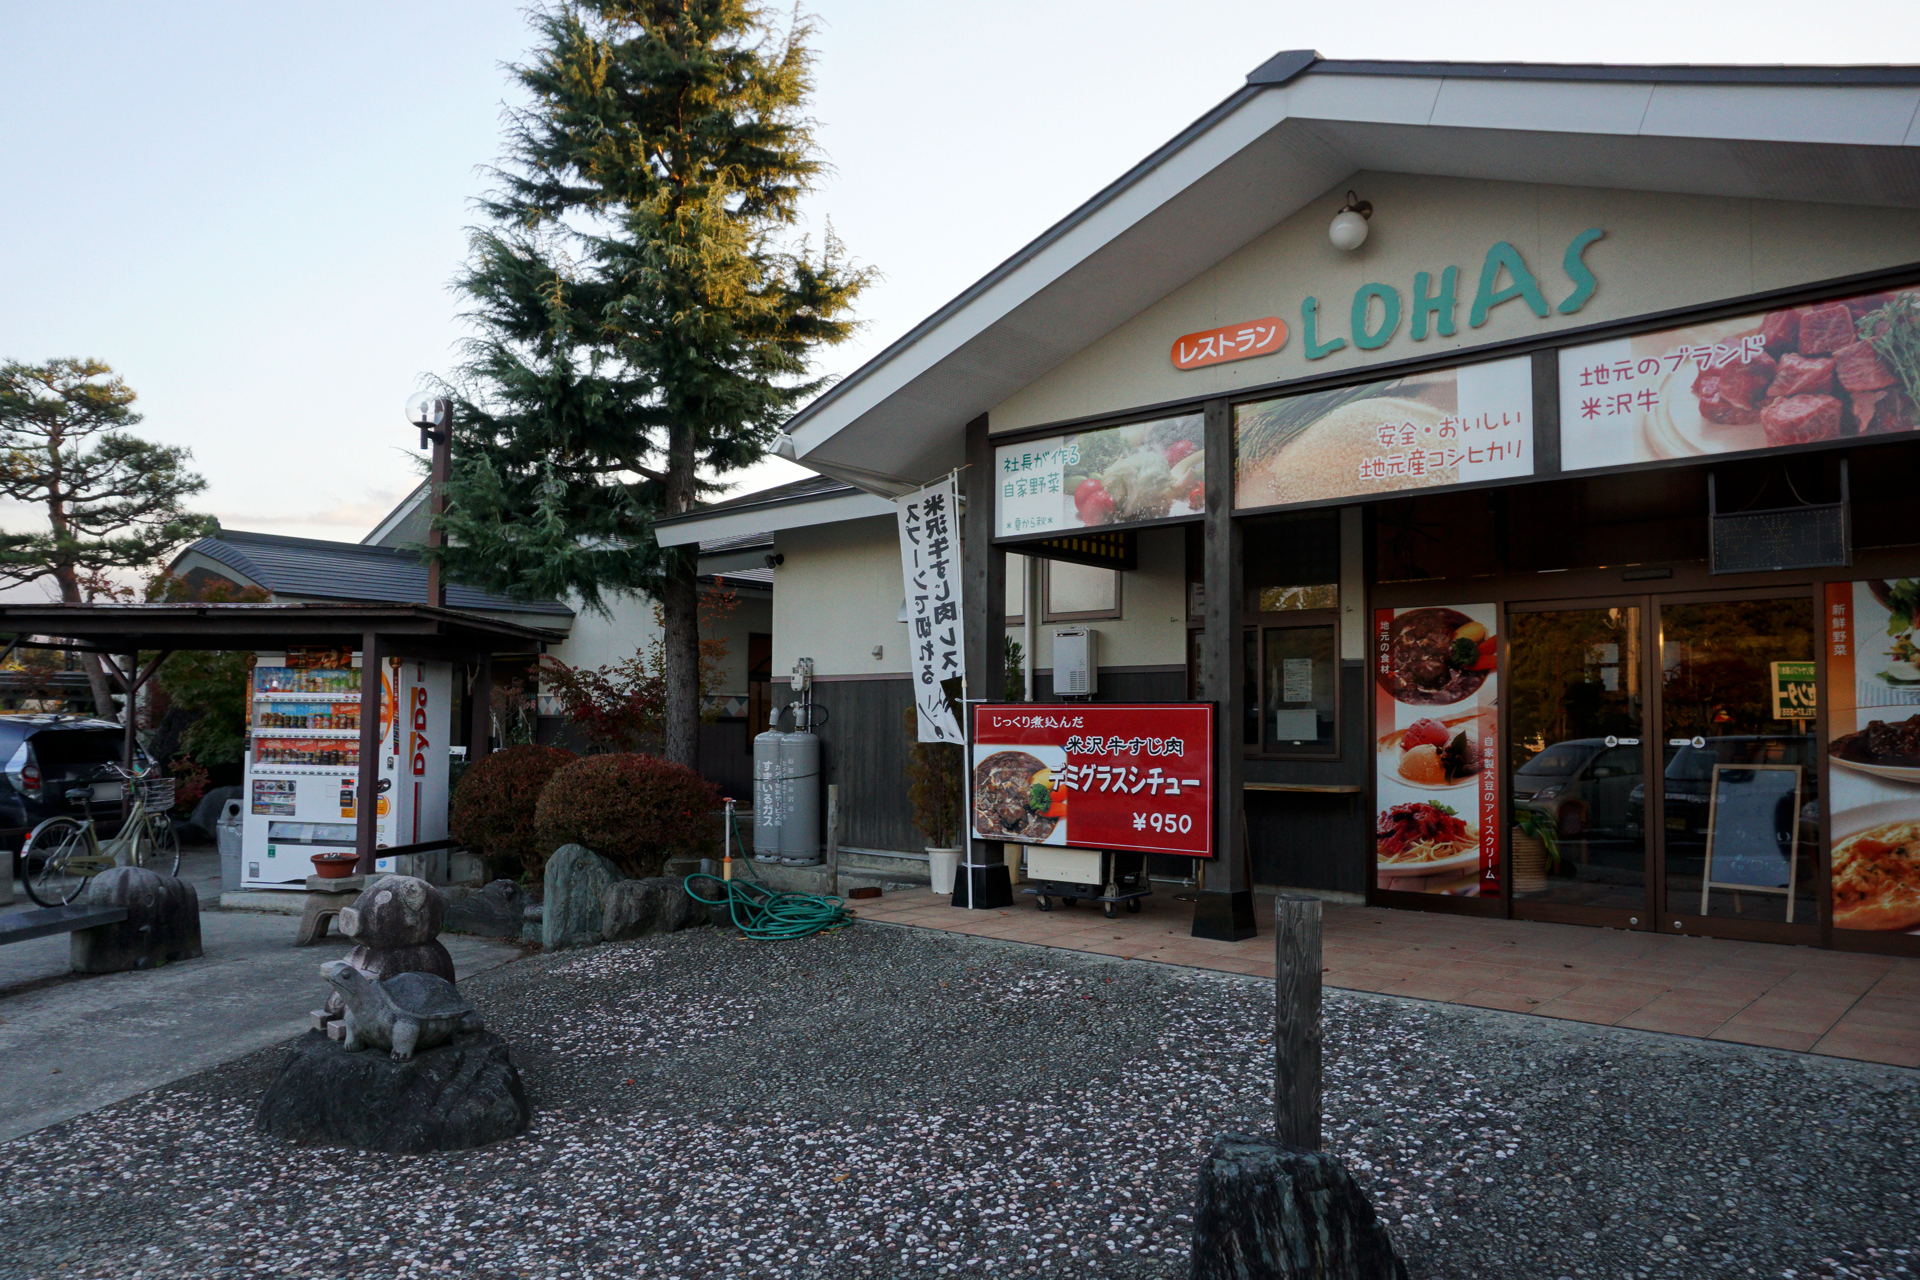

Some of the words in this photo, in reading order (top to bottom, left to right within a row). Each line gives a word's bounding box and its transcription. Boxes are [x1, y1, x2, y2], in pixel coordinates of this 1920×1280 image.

[1303, 227, 1605, 360] LOHAS
[1180, 325, 1276, 364] レストラン
[1580, 334, 1766, 387] 地元のブランド
[1580, 387, 1660, 420] 米沢牛
[1377, 410, 1522, 448] 安全・おいしい
[1003, 444, 1081, 473] 社長が作る
[1360, 439, 1523, 480] 地元産コシヒカリ
[1004, 472, 1060, 498] 自家野菜
[1379, 620, 1390, 675] 地元の食材
[1831, 603, 1847, 656] 新鮮野菜
[413, 687, 430, 776] DyDo
[992, 715, 1085, 729] じっくり煮込んだ
[1065, 735, 1184, 757] 米沢牛すじ肉
[762, 760, 773, 827] すまいるガス
[1048, 762, 1201, 796] デミグラスシチュー
[1132, 812, 1193, 835] ¥950
[1483, 736, 1495, 880] 自家製大豆のアイスクリーム
